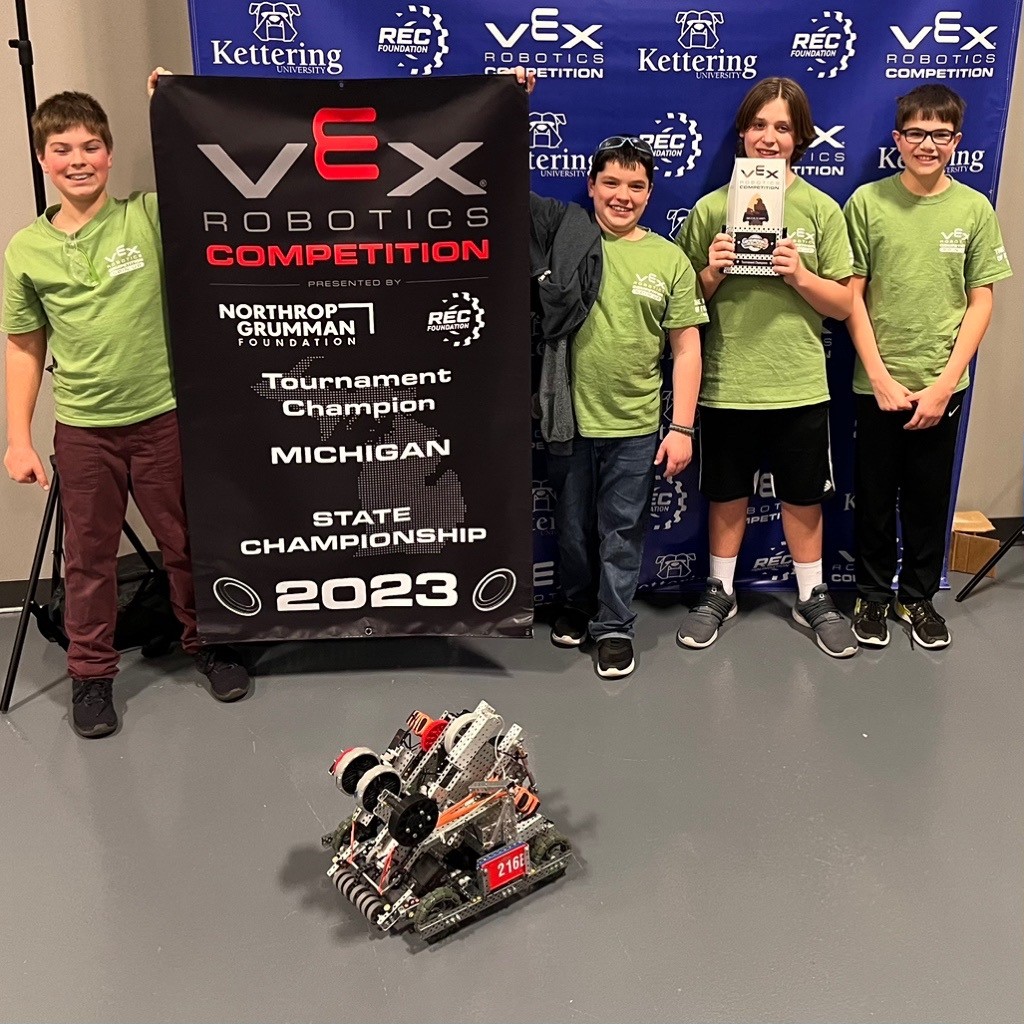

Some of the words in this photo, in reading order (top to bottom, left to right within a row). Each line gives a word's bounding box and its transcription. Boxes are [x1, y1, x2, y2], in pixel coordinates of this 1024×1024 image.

[378, 27, 432, 44] REC
[485, 7, 603, 49] VEX
[889, 11, 998, 50] VEX
[377, 44, 428, 54] FOUNDATION
[792, 32, 841, 49] REC
[211, 40, 342, 74] Kettering
[485, 52, 604, 64] ROBOTICS
[790, 49, 836, 58] FOUNDATION
[886, 53, 995, 64] ROBOTICS
[276, 66, 327, 75] UNIVERSITY
[638, 48, 757, 79] Kettering
[485, 67, 603, 79] CPETITION
[695, 71, 742, 80] UNIVERSITY
[885, 67, 994, 79] COMPETITION
[197, 107, 488, 199] VEX
[529, 148, 594, 176] terin
[741, 165, 779, 179] VEX
[791, 166, 844, 176] TITION
[203, 207, 489, 233] ROBOTICS
[104, 244, 141, 263] VEX
[206, 239, 489, 267] COMPETITION
[219, 303, 338, 320] NORTHROP
[428, 308, 471, 325] REC
[236, 320, 356, 337] GRUMMAN
[427, 322, 470, 332] FOUNDATION
[238, 337, 356, 347] FOUNDATION
[261, 368, 452, 390] Tournament
[282, 398, 436, 418] Champion
[270, 439, 451, 464] MICHIGAN
[312, 506, 411, 527] STATE
[240, 527, 487, 556] CHAMPIONSHIP
[275, 572, 458, 612] 2023
